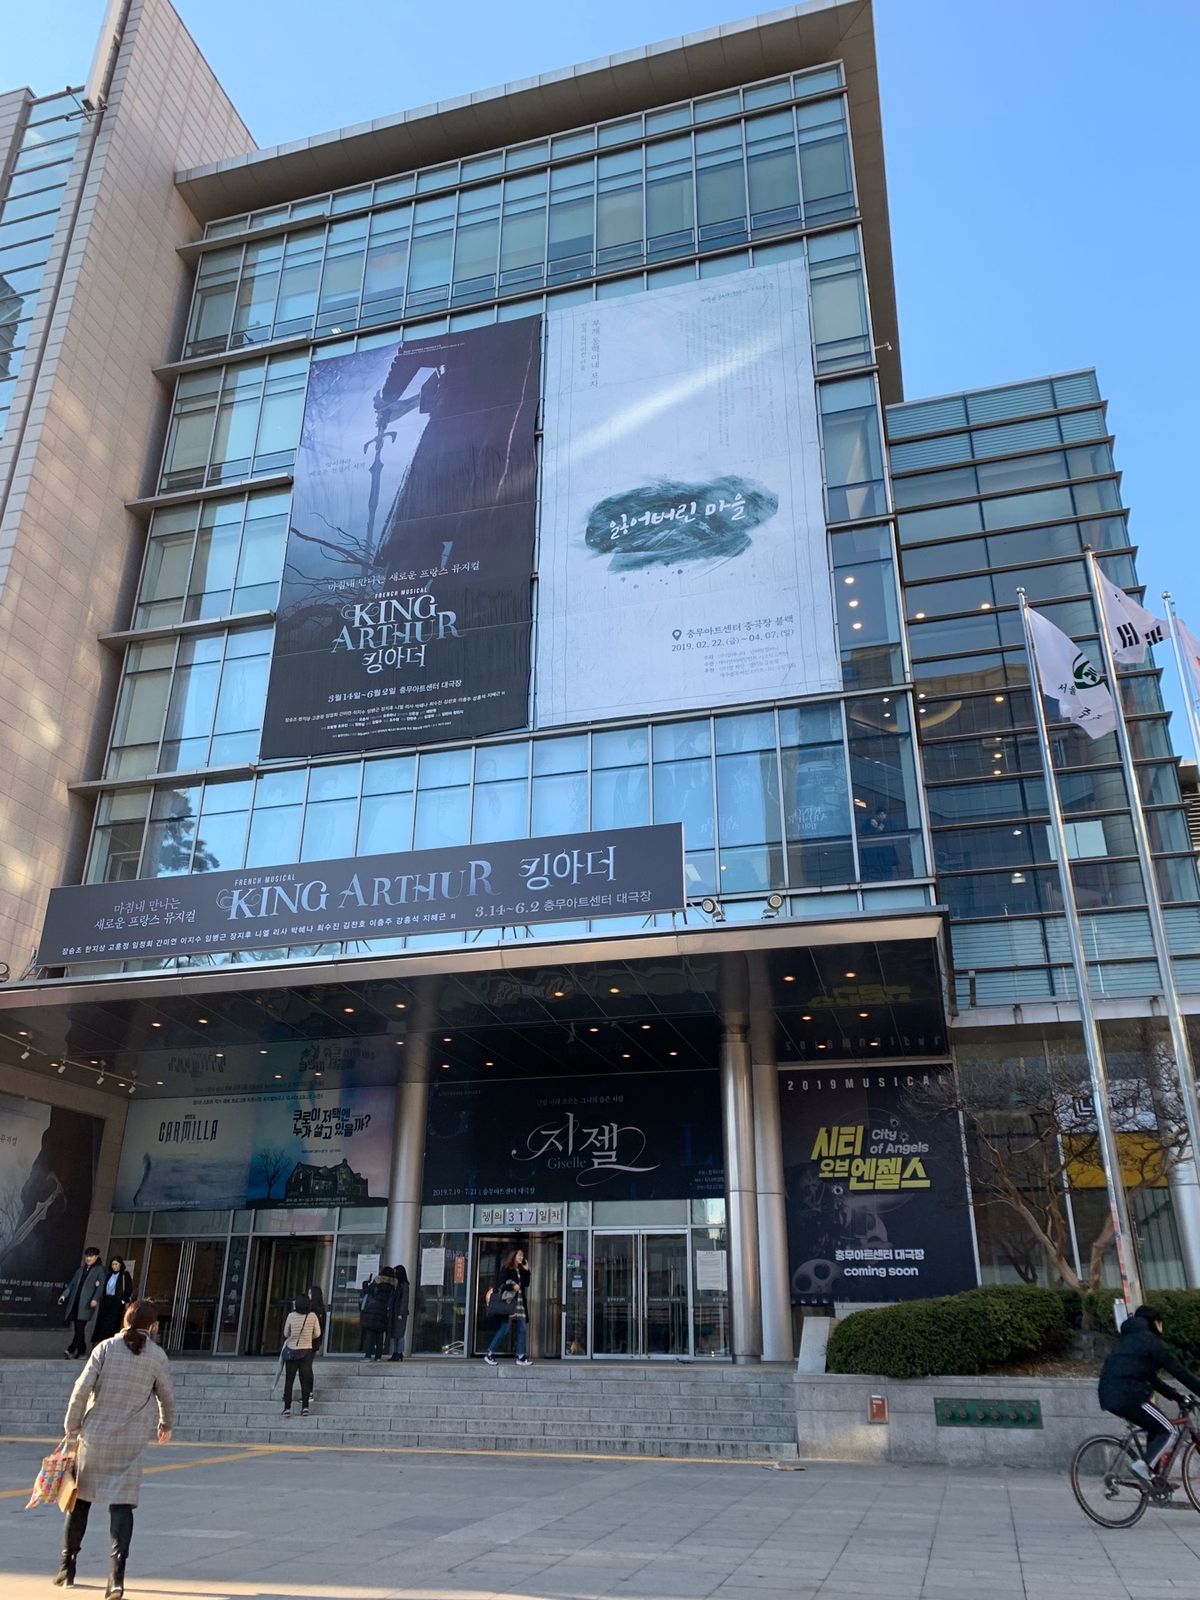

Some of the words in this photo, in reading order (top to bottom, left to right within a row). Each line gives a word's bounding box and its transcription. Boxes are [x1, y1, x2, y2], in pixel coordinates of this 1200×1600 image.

[704, 492, 746, 521] 마을
[388, 571, 417, 582] 새로운
[419, 566, 449, 579] 프랑스
[451, 560, 480, 574] 뮤지컬
[374, 590, 399, 600] FRENCH
[400, 586, 428, 597] MUSICAL
[340, 594, 438, 628] KING
[331, 610, 466, 653] ARTHUR
[686, 622, 741, 639] 충무아트센터
[362, 644, 426, 674] 킹아더
[441, 679, 463, 690] 대극장
[518, 845, 617, 892] 킹아더
[216, 880, 330, 921] KING
[337, 860, 501, 909] ARTHUR
[234, 877, 262, 887] FRENCH
[264, 873, 296, 883] MUSICAL
[113, 900, 146, 914] 마침내
[149, 897, 181, 912] 만나는
[475, 901, 540, 918] 3.14~6.2
[543, 894, 612, 912] 충무아트센터
[616, 890, 652, 904] 대극장
[94, 916, 126, 931] 새로운
[127, 913, 161, 928] 프랑스
[163, 909, 196, 925] 뮤지컬
[85, 944, 106, 954] 한지상
[108, 943, 129, 951] 고훈정
[180, 935, 202, 944] 이지수
[205, 933, 227, 943] 임병근
[229, 931, 252, 941] 장지후
[255, 929, 270, 938] 니엘
[272, 927, 288, 936] 리사
[317, 922, 340, 932] 최수진
[343, 920, 366, 930] 김찬호
[293, 1107, 321, 1125] 쿠로이
[321, 1107, 351, 1123] 저택엔
[293, 1124, 312, 1139] 누가
[314, 1124, 333, 1140] 살고
[334, 1114, 372, 1138] 있을까?
[158, 1119, 219, 1144] CARMILLA
[810, 1125, 865, 1160] 시티
[871, 1128, 898, 1142] City
[870, 1143, 885, 1155] of
[886, 1141, 930, 1155] Angels
[547, 1156, 587, 1170] Giselle
[835, 1249, 893, 1261] 충무아트센터
[894, 1248, 925, 1260] 대극장
[843, 1266, 886, 1278] coming
[888, 1265, 919, 1277] soon
